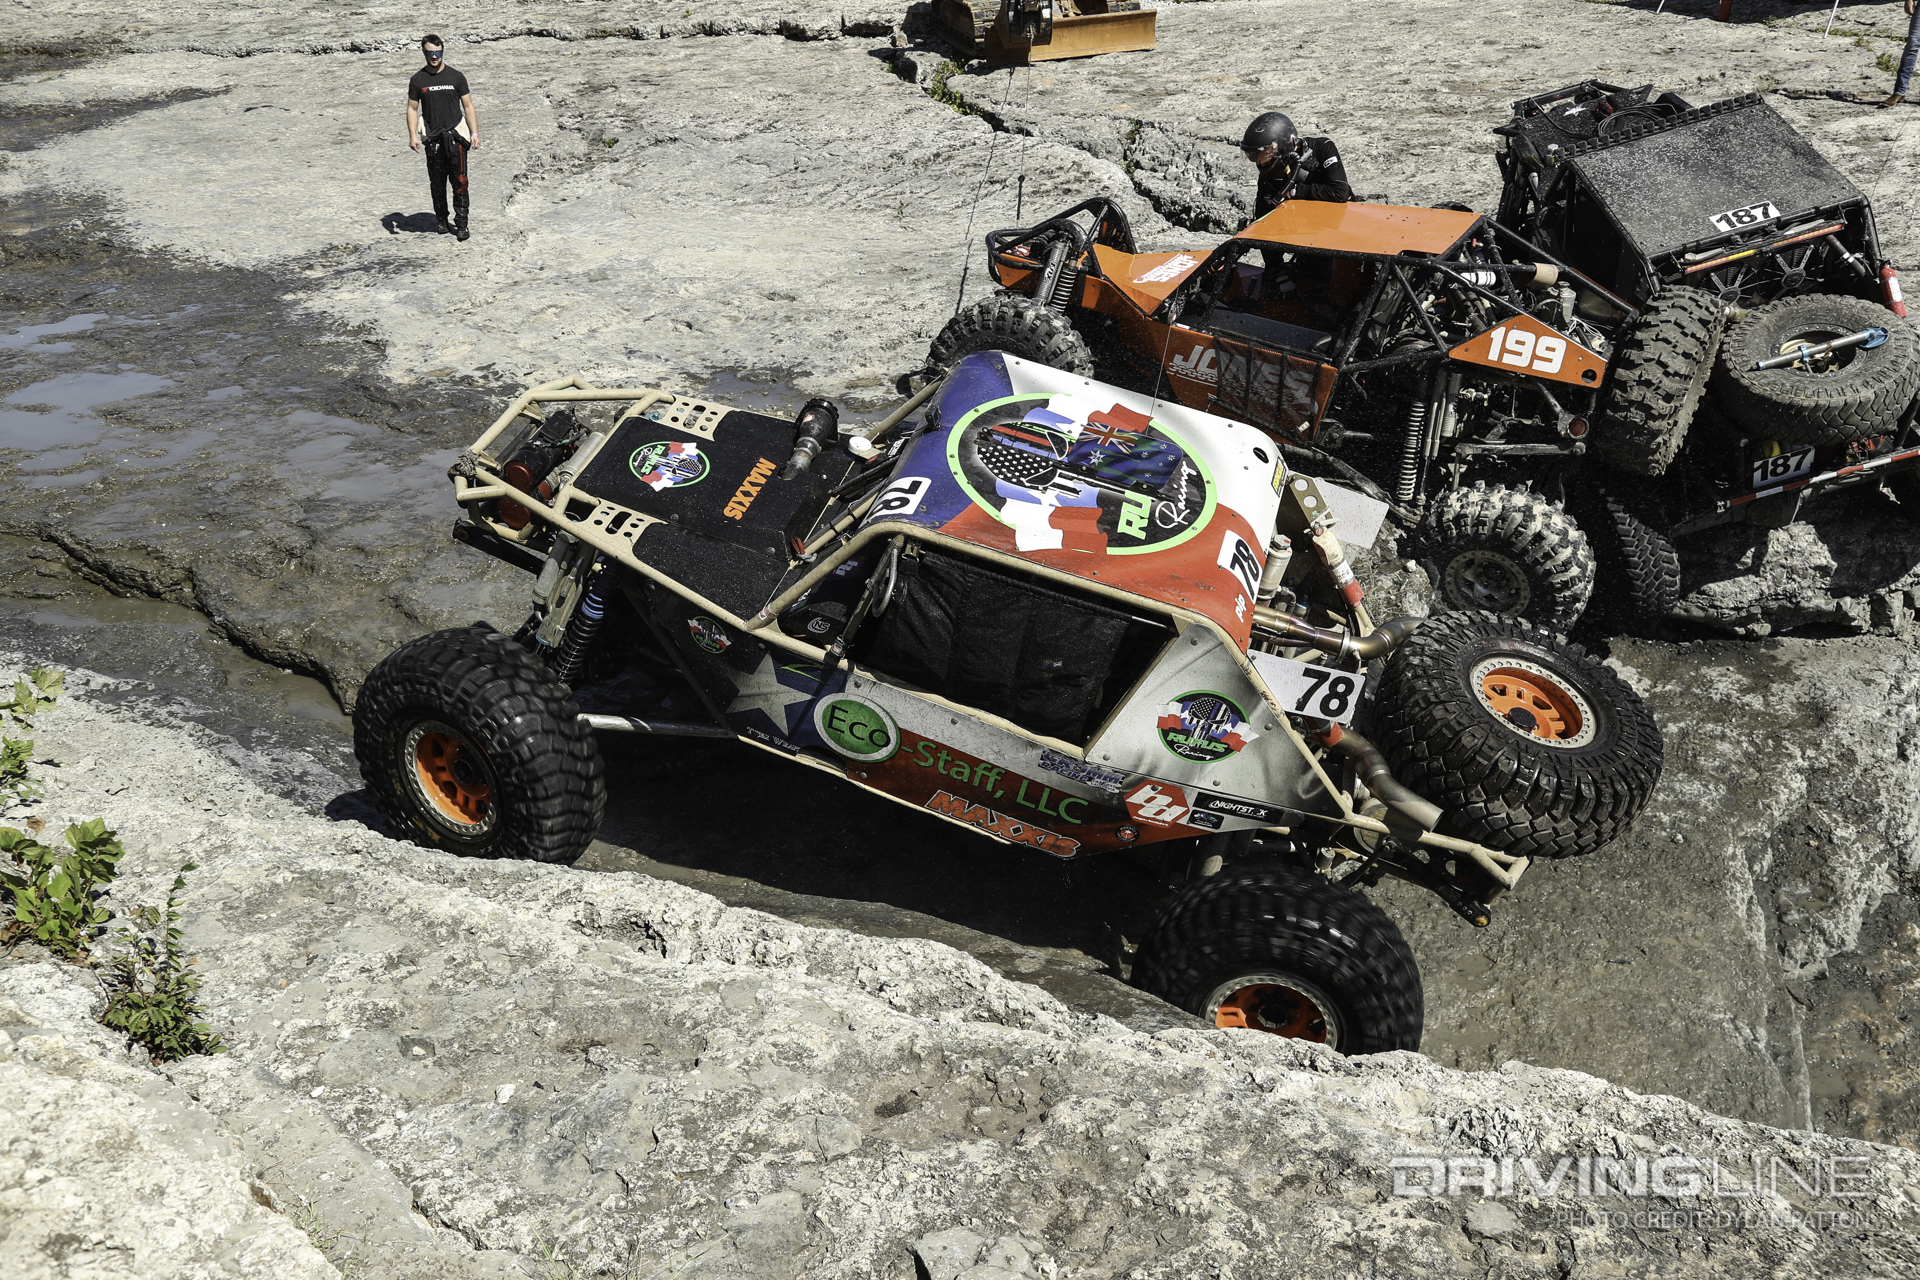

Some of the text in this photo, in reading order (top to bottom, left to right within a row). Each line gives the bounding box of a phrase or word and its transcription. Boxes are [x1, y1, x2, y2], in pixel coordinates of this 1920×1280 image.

[1716, 201, 1770, 230] 187
[1487, 326, 1567, 374] 199
[1754, 450, 1812, 482] 187
[723, 457, 777, 520] MAXXIS
[867, 480, 922, 519] 78
[1156, 460, 1197, 529] Racing
[1230, 538, 1260, 601] 78
[1295, 667, 1355, 718] 78
[1166, 732, 1228, 753] RUFUS
[1174, 743, 1214, 760] Racing
[1040, 761, 1089, 783] RACING
[1016, 779, 1089, 825] LLC
[1210, 799, 1269, 817] NIGHTSTK
[924, 789, 1081, 858] MAXXIS
